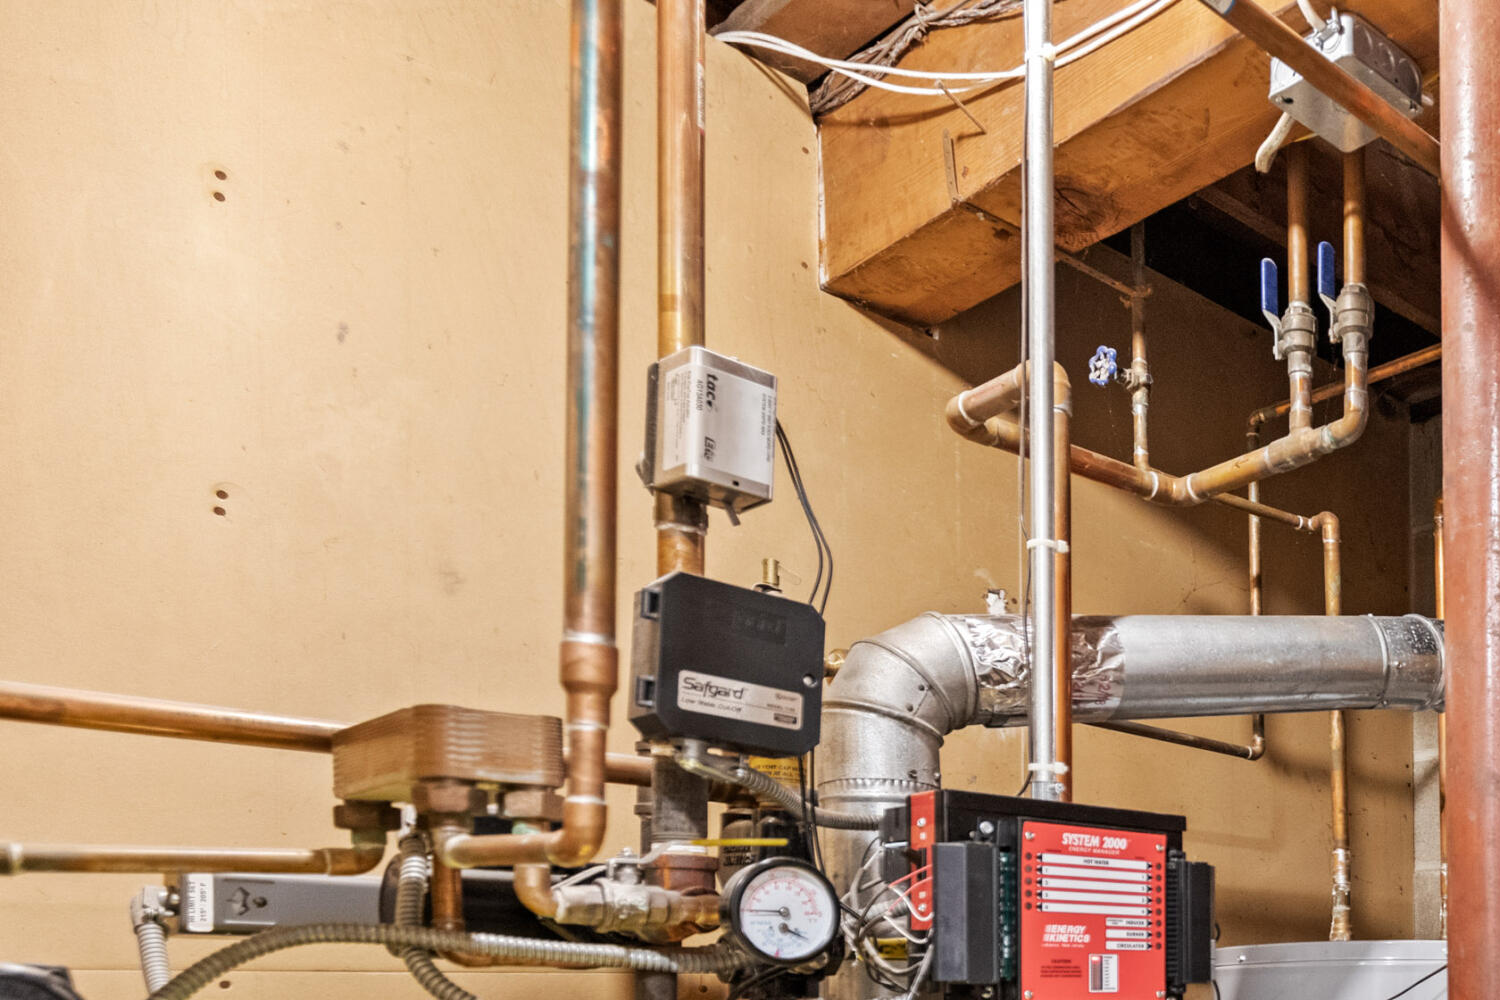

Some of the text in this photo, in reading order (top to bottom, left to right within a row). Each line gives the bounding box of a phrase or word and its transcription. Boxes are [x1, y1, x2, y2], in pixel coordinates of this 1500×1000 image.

[682, 676, 744, 700] Safgard
[1062, 832, 1127, 850] SYSTEM 2000
[1047, 924, 1086, 934] ENERGY
[1046, 934, 1091, 943] KINETICS
